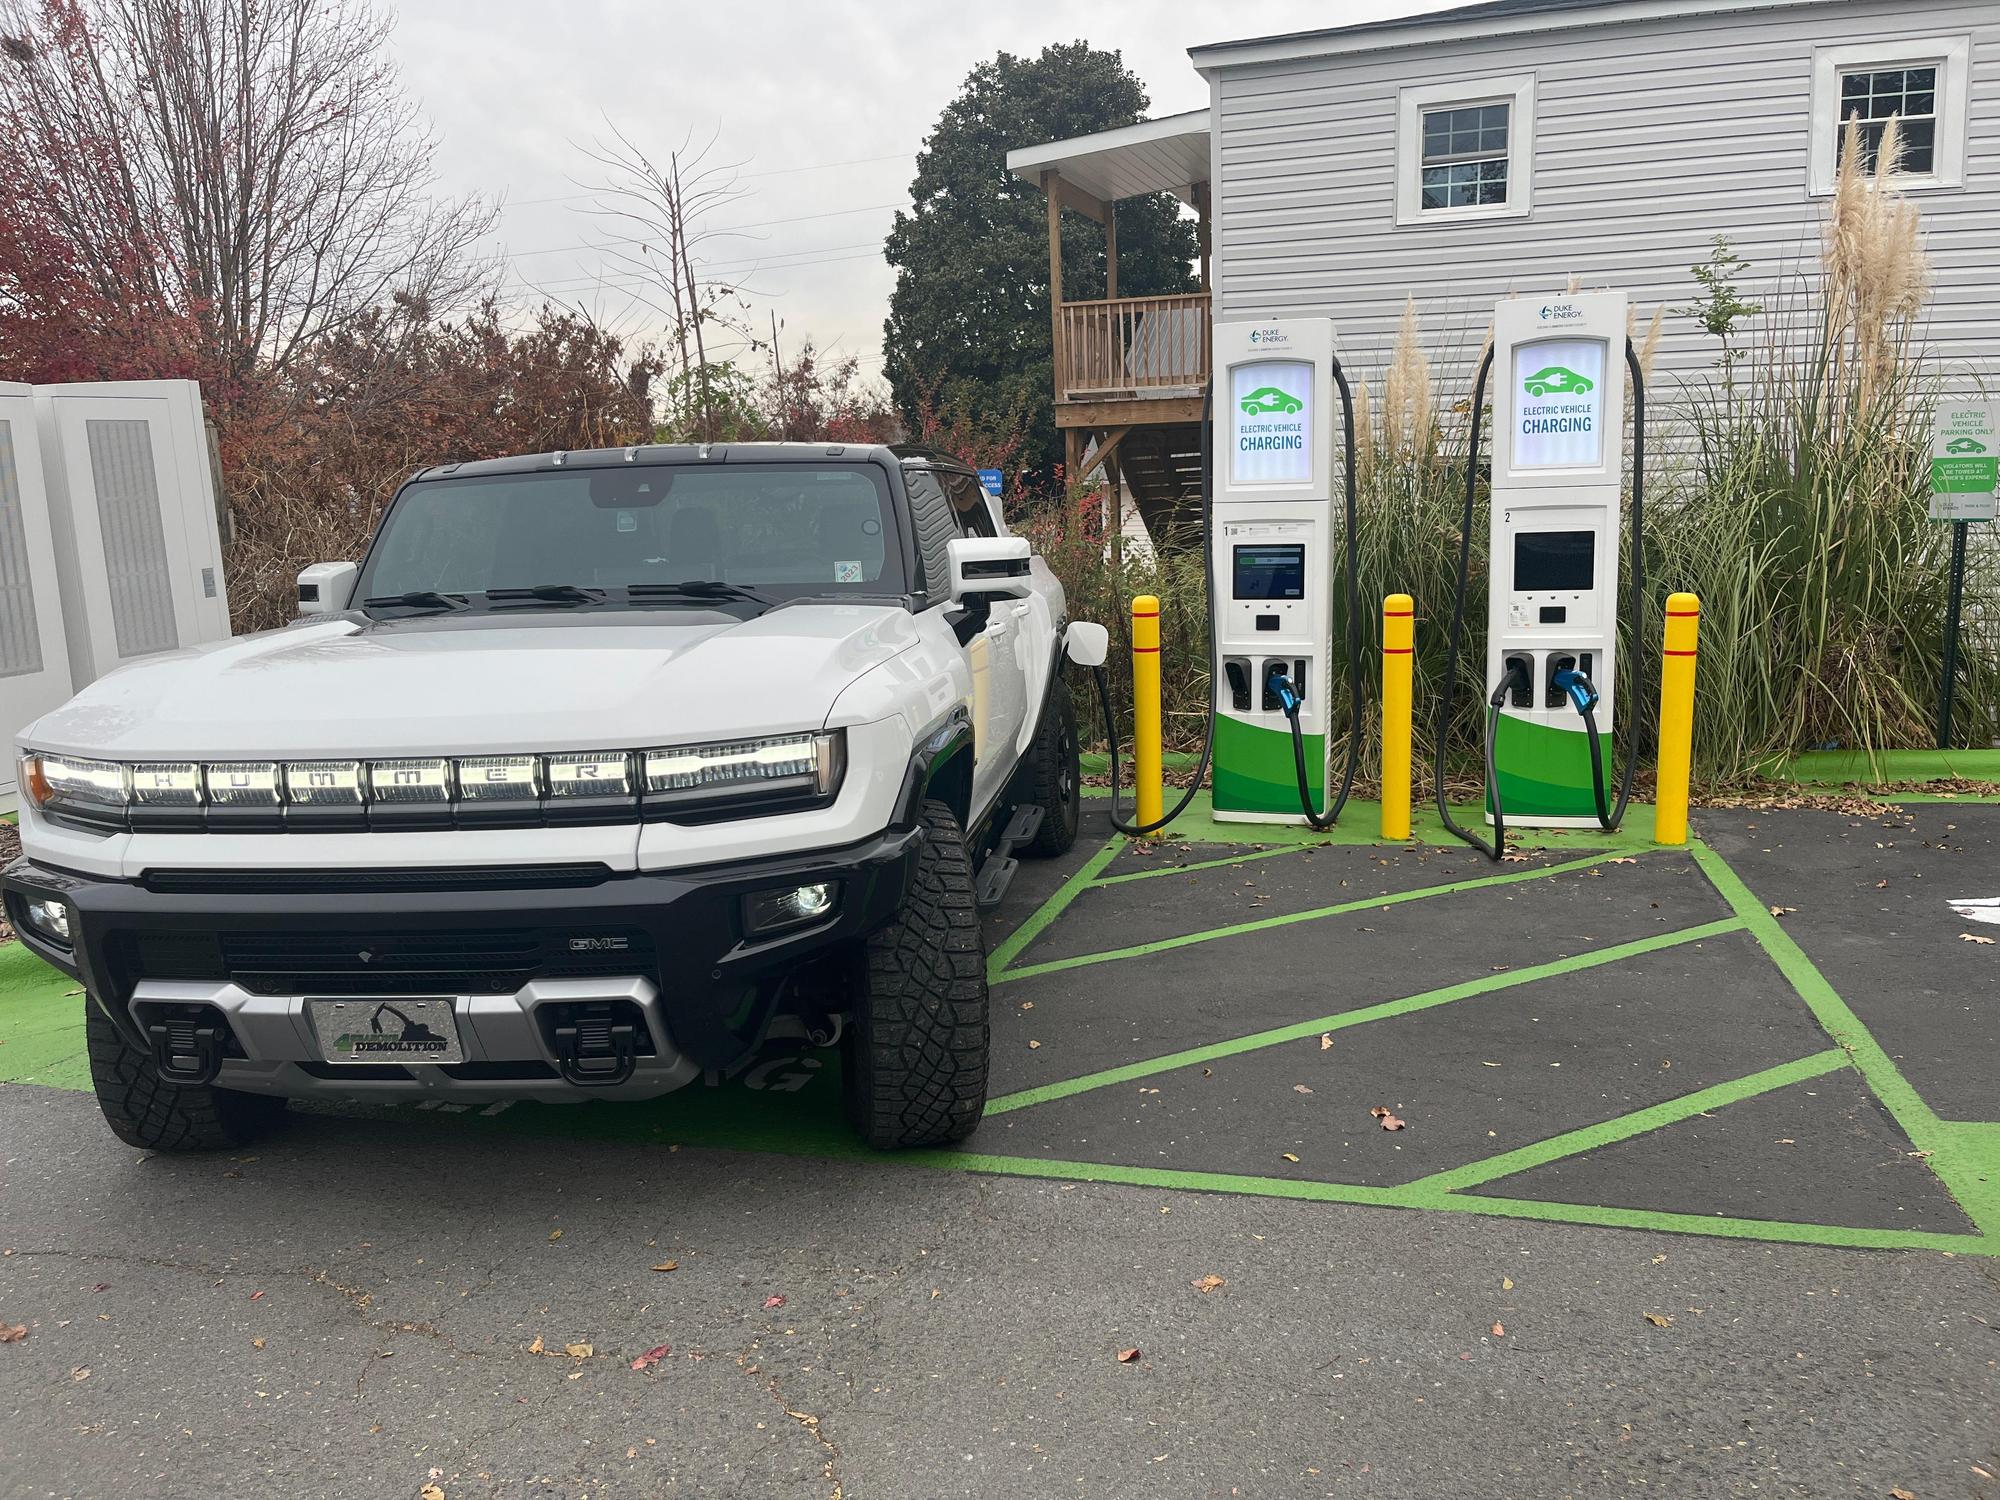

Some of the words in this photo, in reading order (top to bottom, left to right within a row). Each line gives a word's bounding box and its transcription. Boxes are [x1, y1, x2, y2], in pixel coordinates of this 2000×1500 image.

[1523, 406, 1559, 416] ELECTRIC
[1560, 404, 1592, 414] VEHICLE
[1240, 424, 1272, 434] ELECTRIC
[1274, 423, 1302, 433] VEHICLE
[1522, 417, 1592, 434] CHARGING
[1240, 435, 1302, 451] CHARGING
[1505, 513, 1511, 523] 2
[154, 764, 600, 787] HUMMER
[569, 937, 629, 950] GMC
[354, 1041, 448, 1052] DEMOLITION
